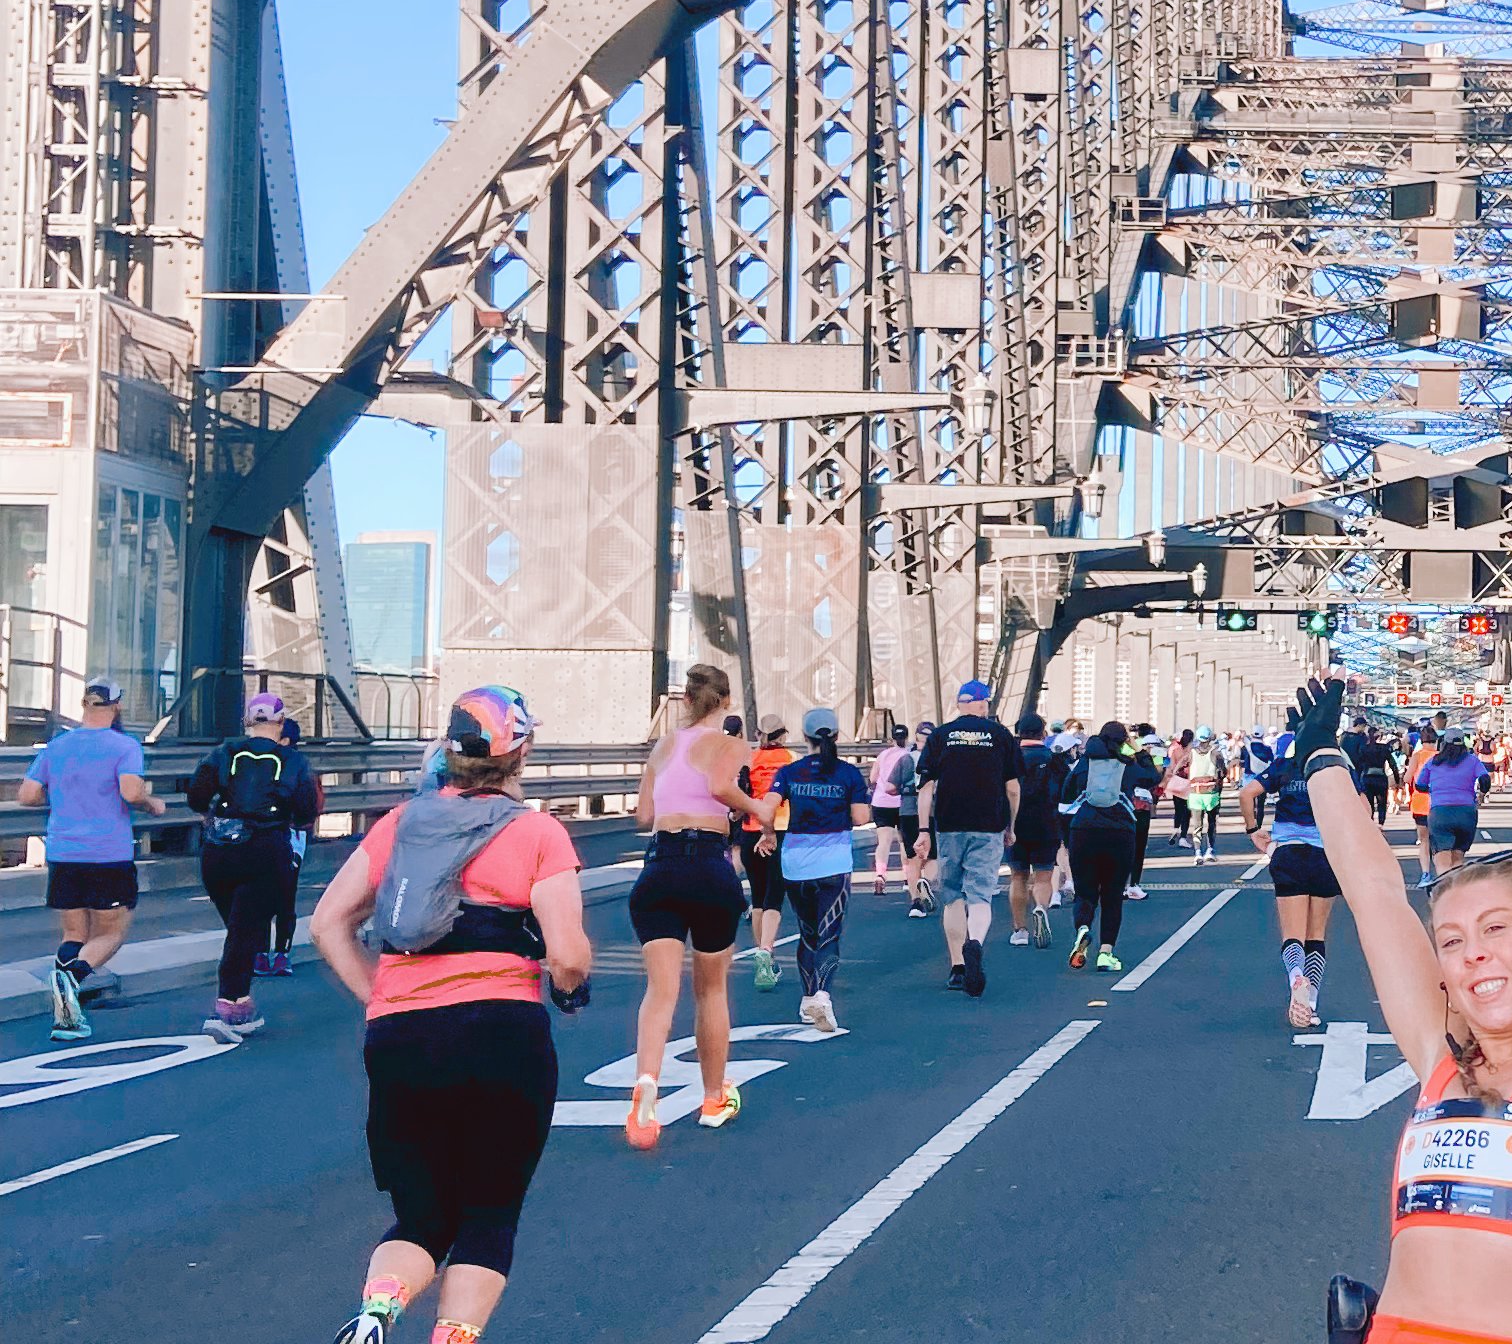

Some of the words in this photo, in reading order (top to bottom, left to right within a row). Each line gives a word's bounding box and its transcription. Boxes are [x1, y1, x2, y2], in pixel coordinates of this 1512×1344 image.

[1218, 616, 1227, 626] 6
[1246, 616, 1255, 627] 6
[1299, 616, 1308, 627] 5
[1327, 616, 1336, 628] 5
[1461, 619, 1470, 629] 3
[1489, 618, 1498, 629] 3
[948, 730, 992, 740] CRONULLA
[391, 877, 409, 928] SALOMON
[1422, 1128, 1490, 1149] D42266
[1423, 1152, 1476, 1169] GISELLE
